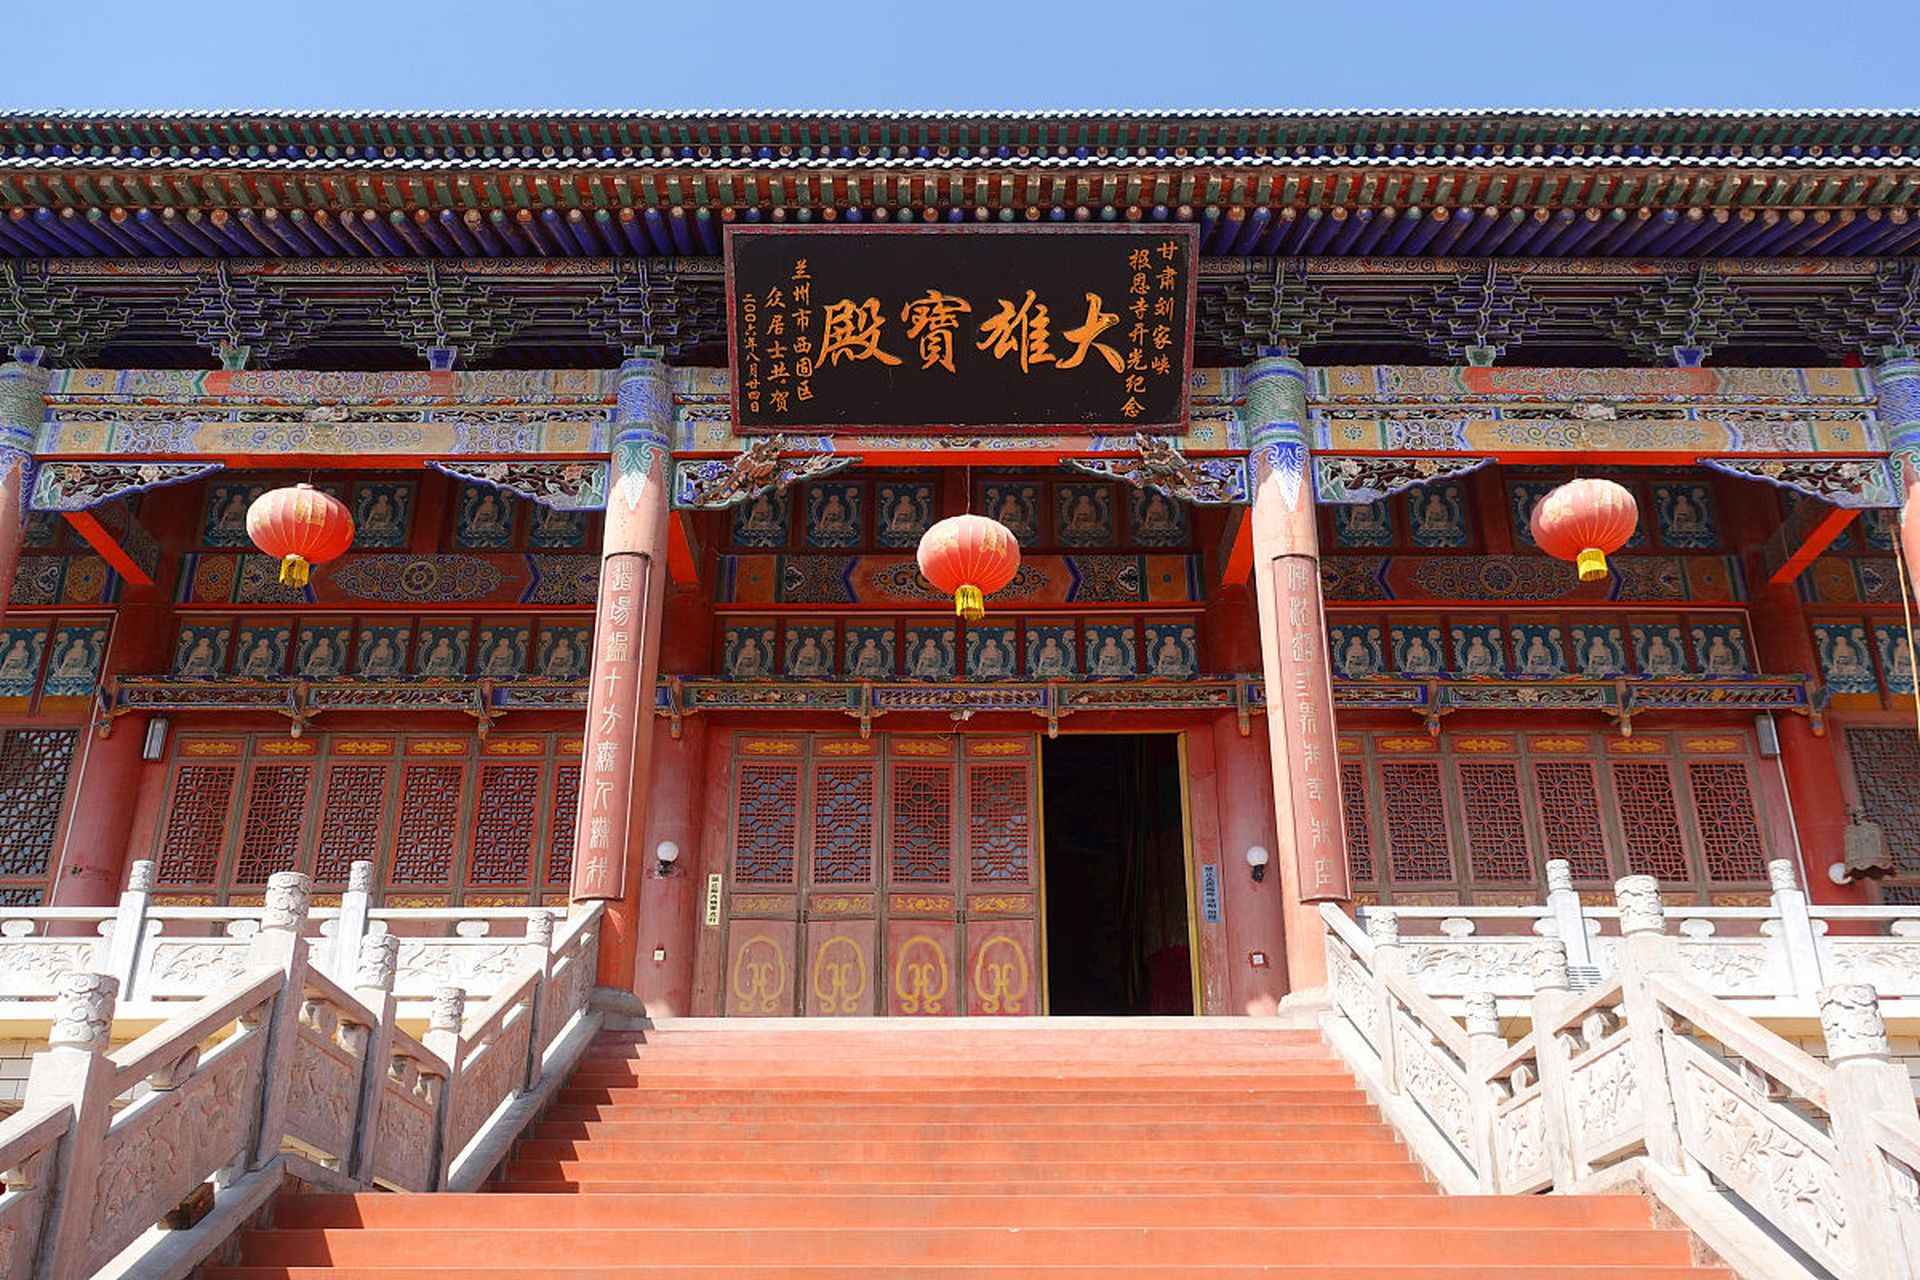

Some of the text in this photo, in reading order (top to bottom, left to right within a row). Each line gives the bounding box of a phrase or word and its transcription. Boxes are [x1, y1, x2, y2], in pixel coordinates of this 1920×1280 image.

[791, 258, 814, 401] 兰州市西固区
[814, 289, 1125, 374] 大雄寶殿
[1121, 249, 1152, 418] 报恩寺开光纪念
[1151, 240, 1179, 375] 甘肃刘家峡
